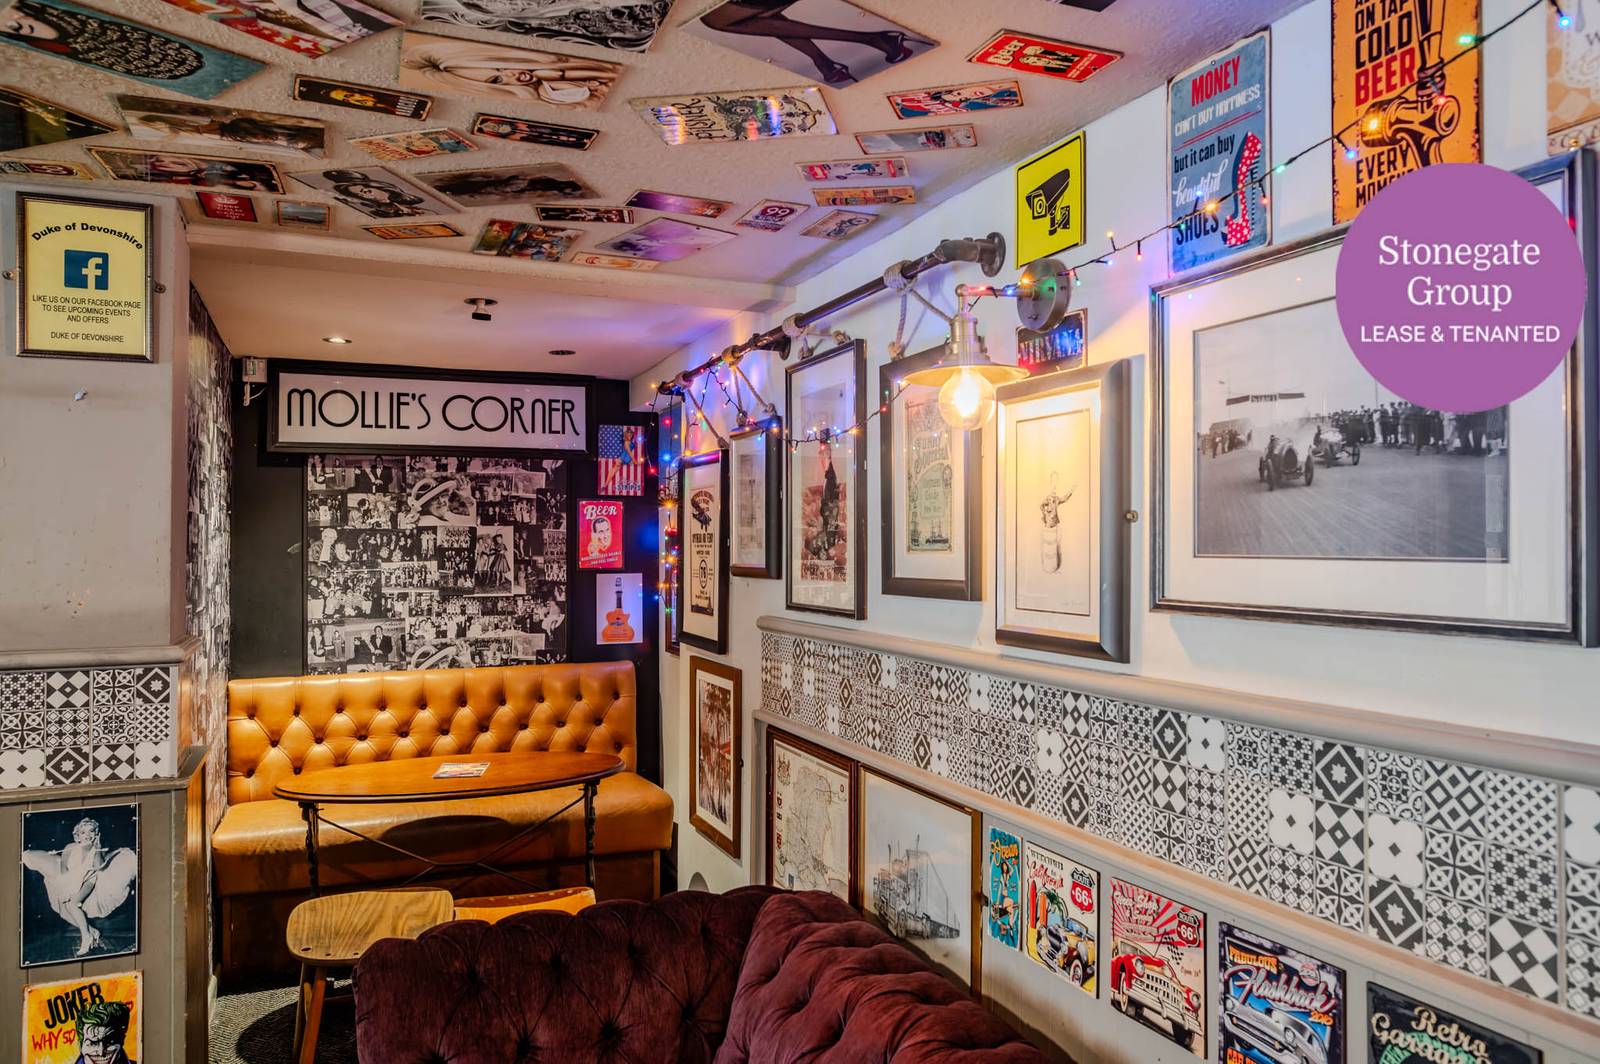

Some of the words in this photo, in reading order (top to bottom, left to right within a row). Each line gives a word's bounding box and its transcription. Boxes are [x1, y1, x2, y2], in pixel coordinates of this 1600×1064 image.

[1356, 3, 1375, 34] ON
[1356, 10, 1412, 70] COLD
[1192, 55, 1240, 107] MONEY
[1356, 46, 1415, 108] BEER
[1198, 106, 1214, 126] BUY
[1174, 156, 1189, 174] but
[1190, 149, 1197, 166] it
[1199, 142, 1215, 162] can
[1218, 134, 1235, 154] buy
[1356, 141, 1410, 184] EVERY
[1172, 158, 1228, 207] beautiful
[1356, 168, 1414, 208] MOM
[32, 225, 61, 241] Duke
[65, 222, 76, 230] of
[80, 223, 143, 250] Devonshire
[1176, 211, 1219, 246] SHOES
[32, 294, 47, 302] LIKE
[49, 296, 58, 304] US
[60, 296, 70, 304] ON
[71, 297, 86, 306] OUR
[88, 298, 122, 308] FACEBOOK
[124, 300, 142, 309] PAGE
[68, 306, 104, 316] UPCOMING
[105, 308, 131, 316] EVENTS
[67, 314, 81, 323] AND
[82, 316, 109, 324] OFFERS
[51, 332, 69, 340] DUKE
[71, 332, 80, 340] OF
[82, 333, 124, 342] DEVONSHIRE
[287, 388, 430, 430] MOLLIE'S
[442, 394, 580, 436] CORNER
[1073, 873, 1092, 886] ROUTE
[1075, 887, 1088, 908] 66
[1180, 924, 1193, 940] 66
[1229, 944, 1278, 974] FABULOUS
[1224, 964, 1337, 1012] Flashback
[44, 982, 105, 1029] JOKER
[32, 1028, 62, 1052] WHY
[1411, 1006, 1490, 1058] Retro
